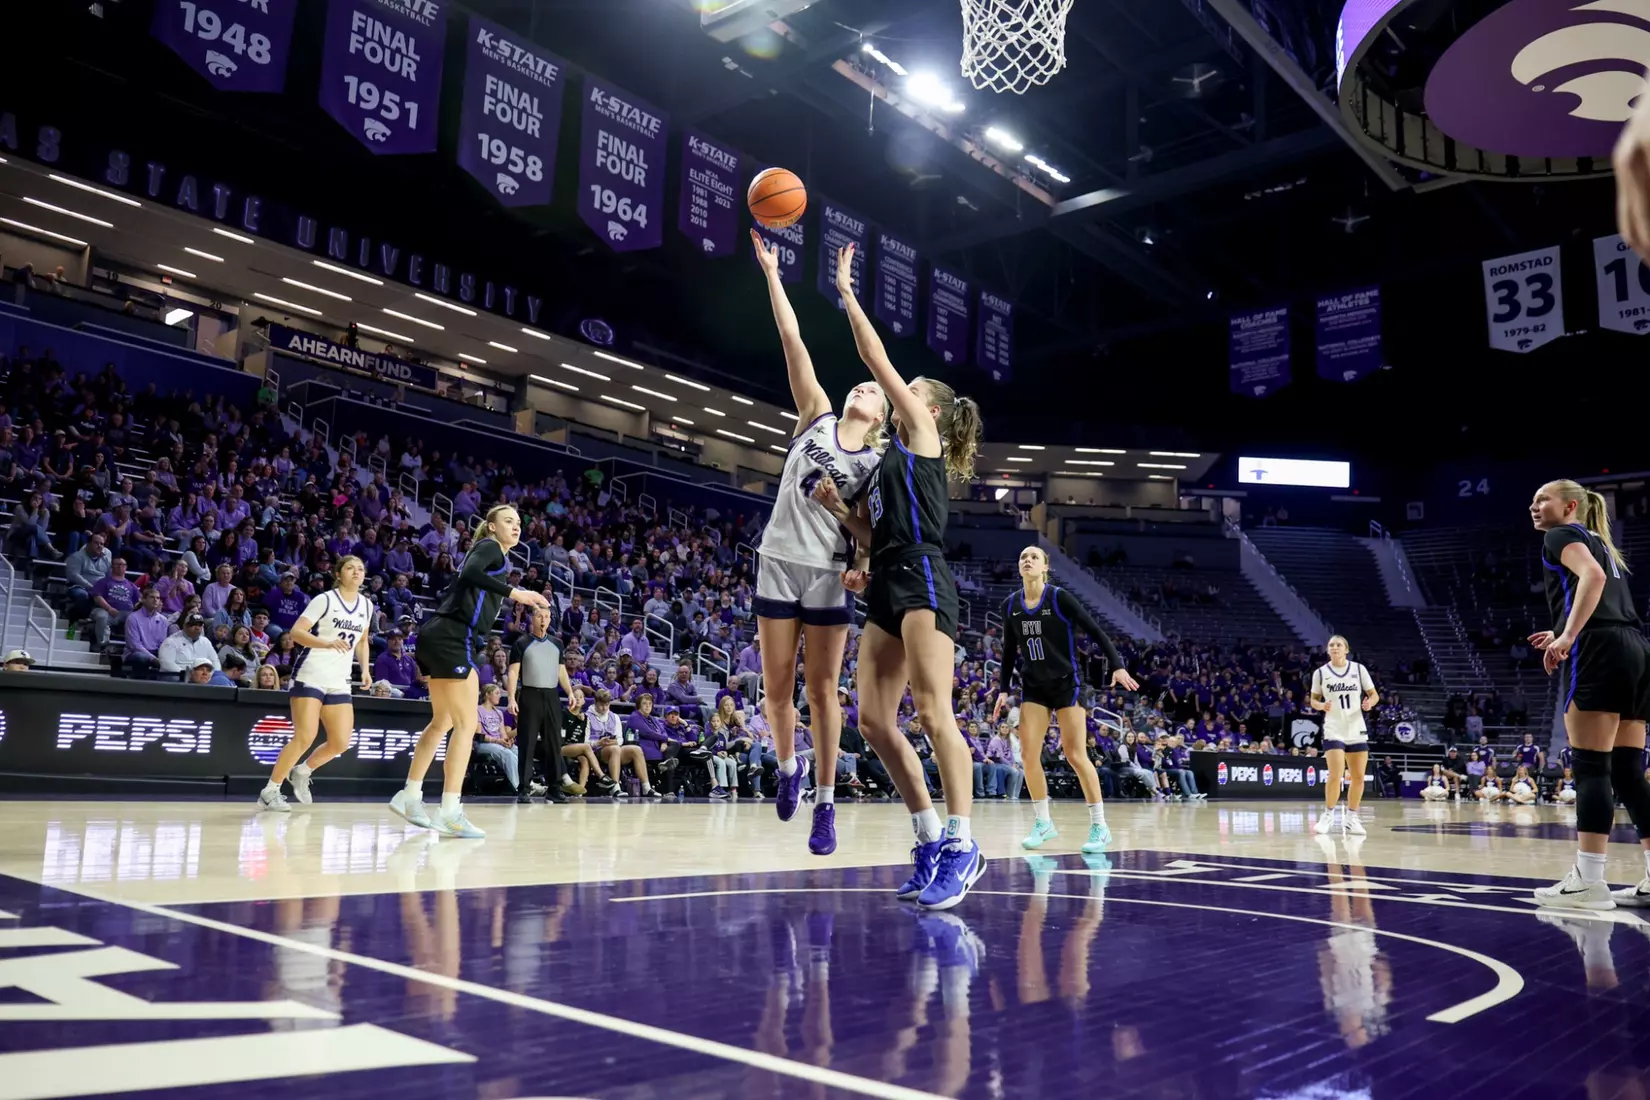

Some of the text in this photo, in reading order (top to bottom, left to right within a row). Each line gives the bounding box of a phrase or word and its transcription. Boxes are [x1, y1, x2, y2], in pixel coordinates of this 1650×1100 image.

[180, 1, 271, 64] 1948
[352, 10, 420, 61] FINAL
[349, 32, 417, 82] FOUR
[477, 28, 559, 81] K-STATE
[507, 55, 551, 87] BASKETBALL
[344, 75, 418, 130] 1951
[485, 74, 543, 119] FINAL
[590, 87, 661, 133] K-STATE
[483, 95, 541, 138] FOUR
[616, 112, 655, 139] BASKETBALL
[478, 133, 543, 182] 1958
[598, 130, 648, 169] FINAL
[688, 136, 737, 168] K-STATE
[596, 149, 646, 187] FOUR
[689, 168, 733, 196] ELITE EIGHT
[106, 149, 262, 232] STATE
[591, 184, 648, 229] 1964
[825, 206, 864, 234] K-STATE
[880, 235, 916, 260] K-STATE
[297, 215, 544, 323] UNIVERSITY
[934, 268, 967, 292] K-STATE
[1490, 256, 1553, 277] ROMSTAD
[1492, 272, 1555, 323] 33
[1619, 308, 1650, 319] 1981-
[1504, 324, 1546, 338] 1979-82
[801, 439, 849, 489] Wildcats
[332, 618, 363, 633] Wildcats
[1022, 620, 1042, 636] BYU
[1027, 637, 1045, 660] 11
[1326, 682, 1359, 693] Wildcats
[1339, 694, 1350, 709] 11
[57, 713, 213, 754] PEPSI
[1231, 766, 1258, 782] PEPSI
[1278, 768, 1302, 783] PEPSI
